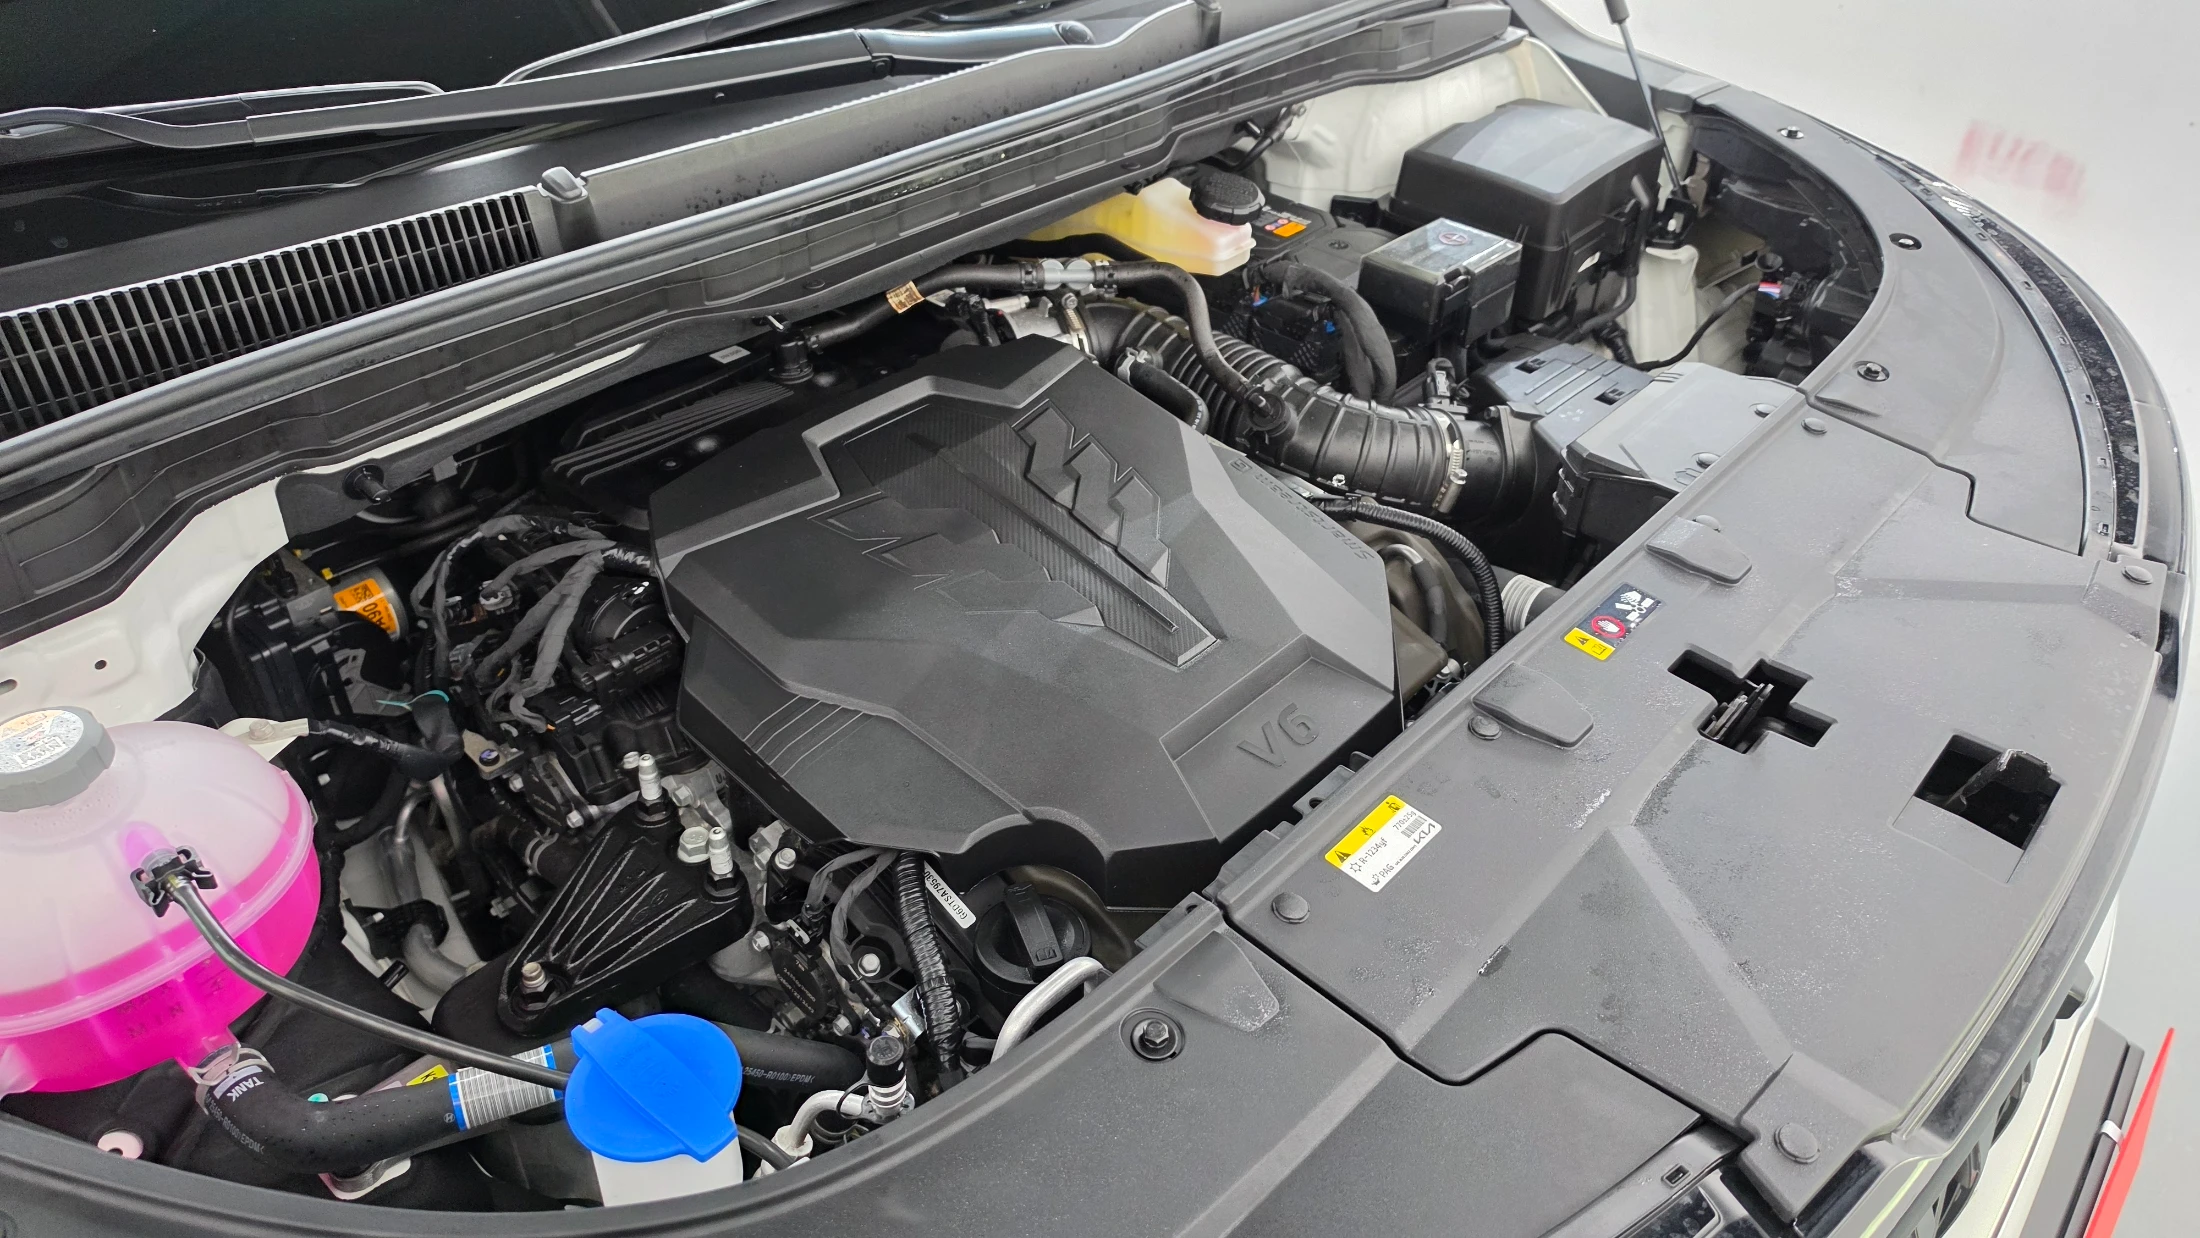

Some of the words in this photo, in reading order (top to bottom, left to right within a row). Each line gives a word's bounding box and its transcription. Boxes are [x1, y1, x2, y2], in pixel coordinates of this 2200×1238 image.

[1236, 702, 1319, 768] V6
[1413, 822, 1436, 845] KIA
[1358, 837, 1388, 865] R-1234yf
[1379, 863, 1395, 878] PAG
[226, 1076, 265, 1102] TANK
